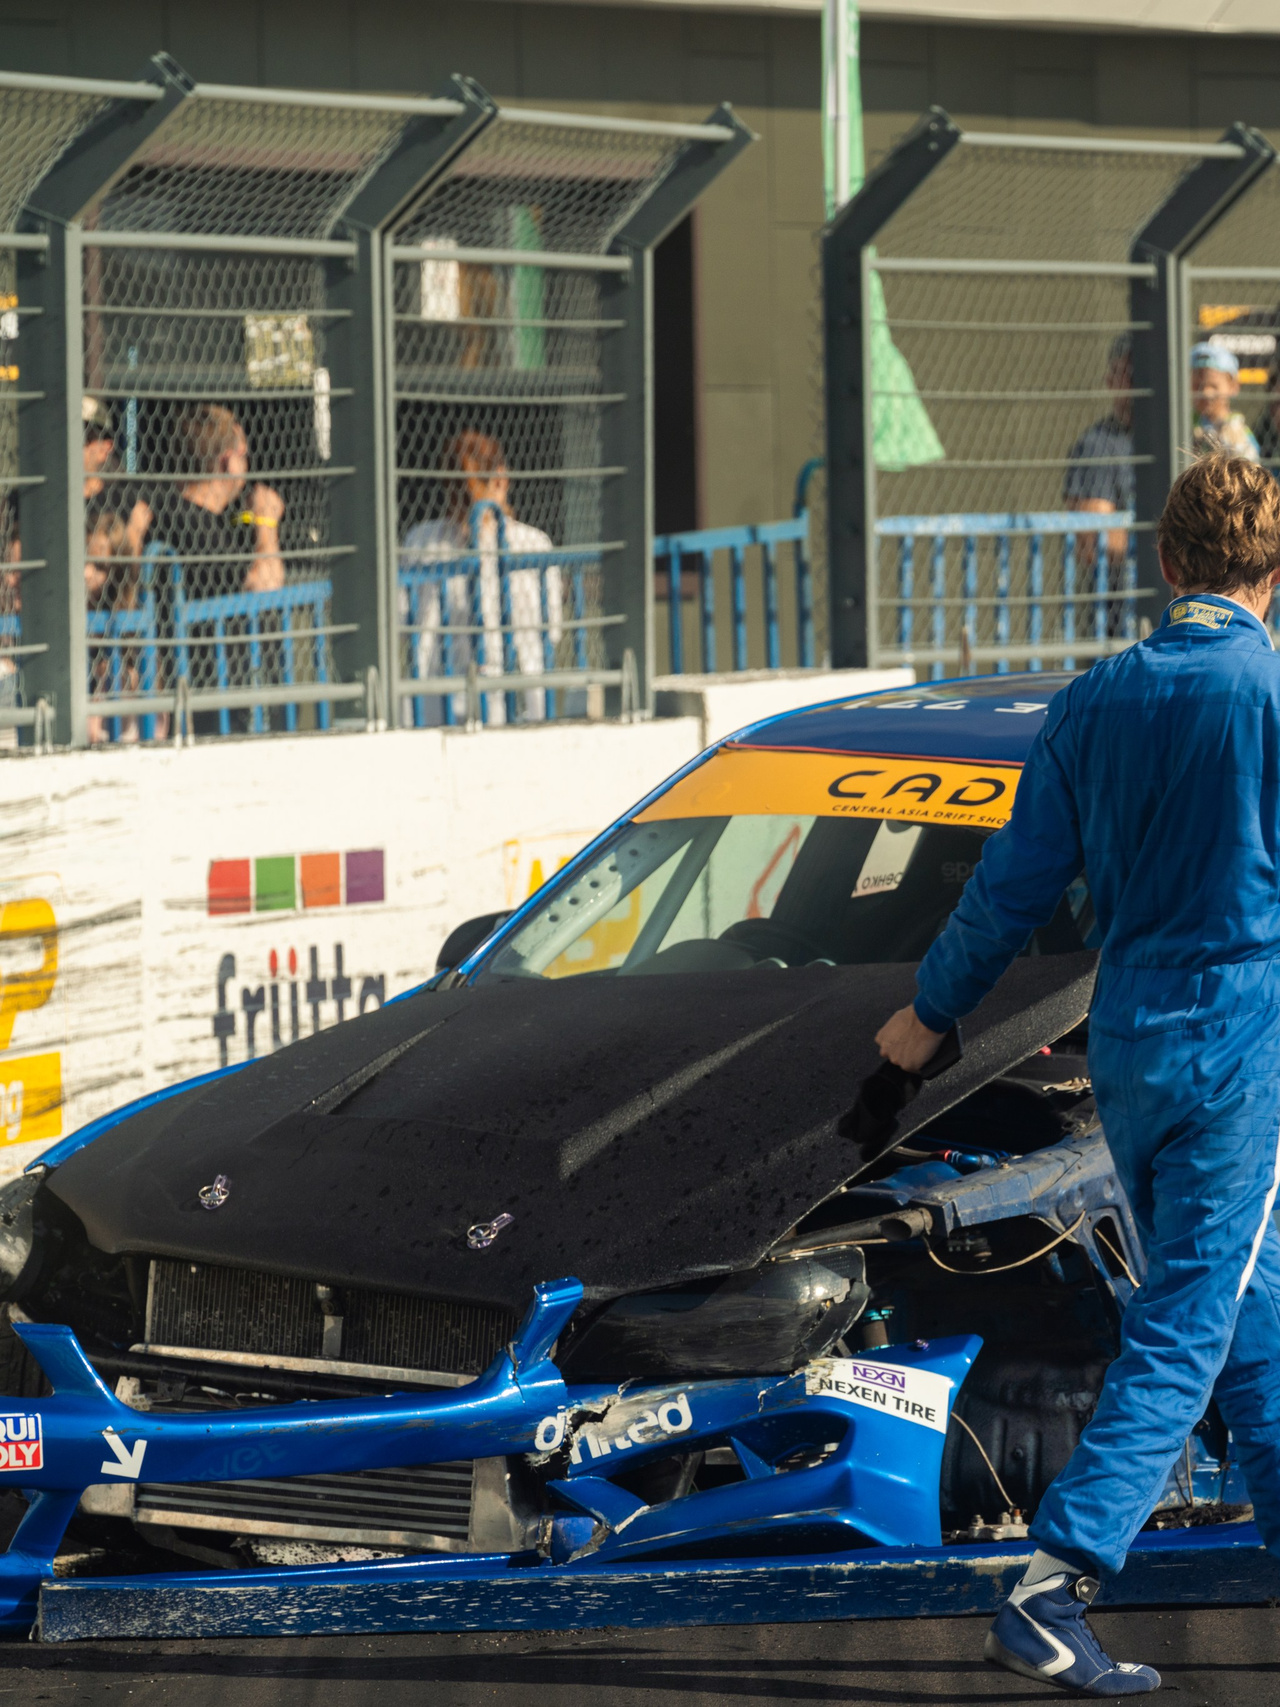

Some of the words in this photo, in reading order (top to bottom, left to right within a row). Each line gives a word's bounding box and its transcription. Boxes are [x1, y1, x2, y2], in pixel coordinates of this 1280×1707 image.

[827, 770, 1012, 811] CAD
[832, 804, 893, 815] CENTRAL
[899, 809, 929, 818] ASIA
[933, 811, 976, 822] DRIFT
[977, 815, 1010, 826] SHO
[852, 1364, 906, 1390] NEXEN
[819, 1378, 887, 1406] NEXEN
[892, 1396, 936, 1422] TIRE
